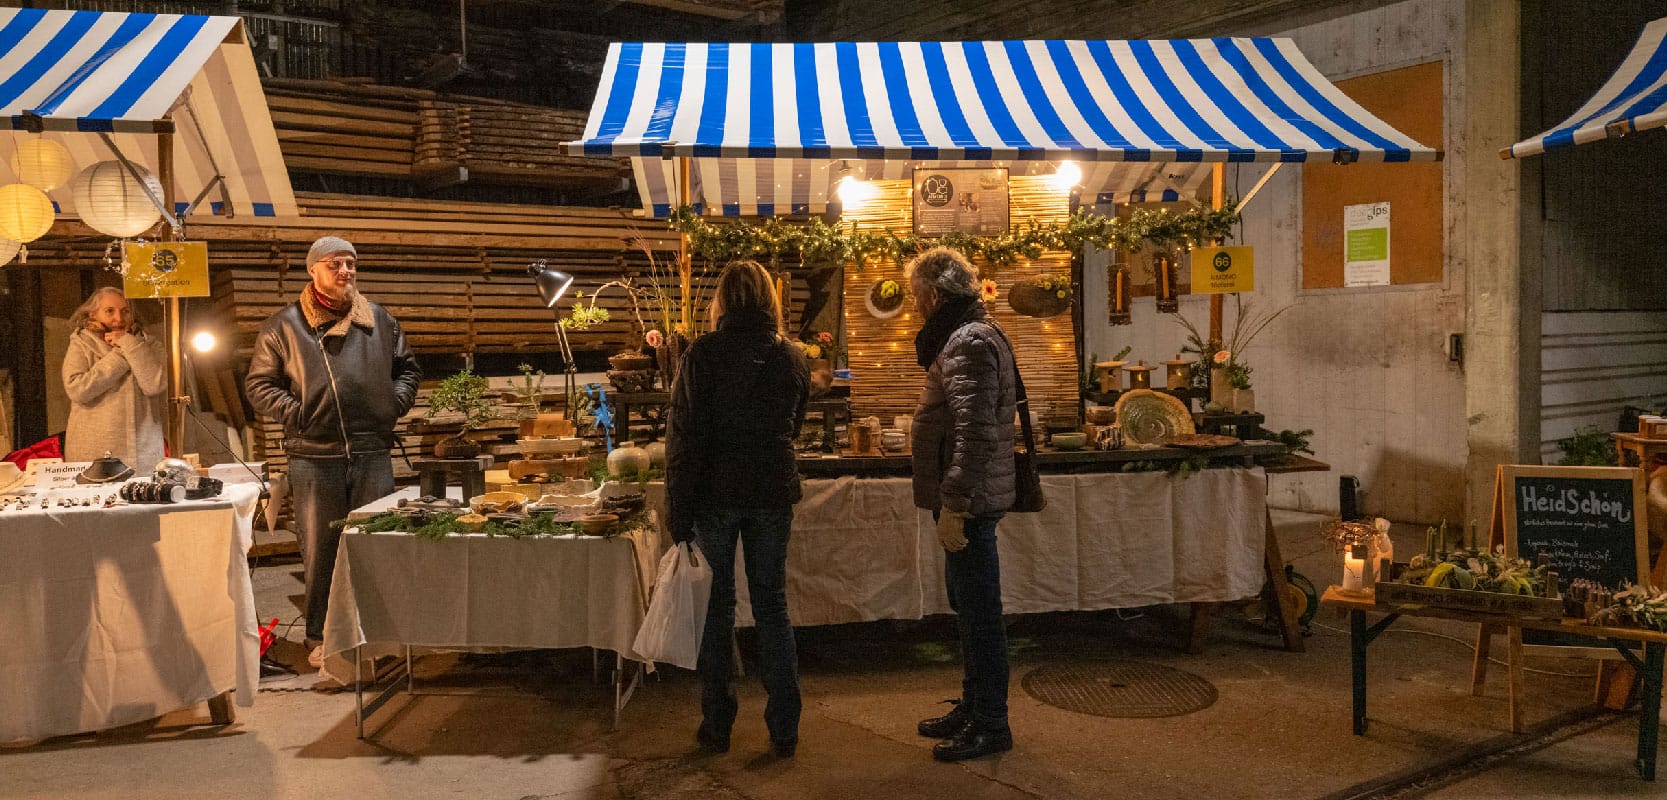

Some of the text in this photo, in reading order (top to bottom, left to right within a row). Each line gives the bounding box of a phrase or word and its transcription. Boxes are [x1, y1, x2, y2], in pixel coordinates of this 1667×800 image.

[155, 255, 174, 267] 65
[1214, 256, 1231, 267] 66
[45, 465, 87, 474] Handmad
